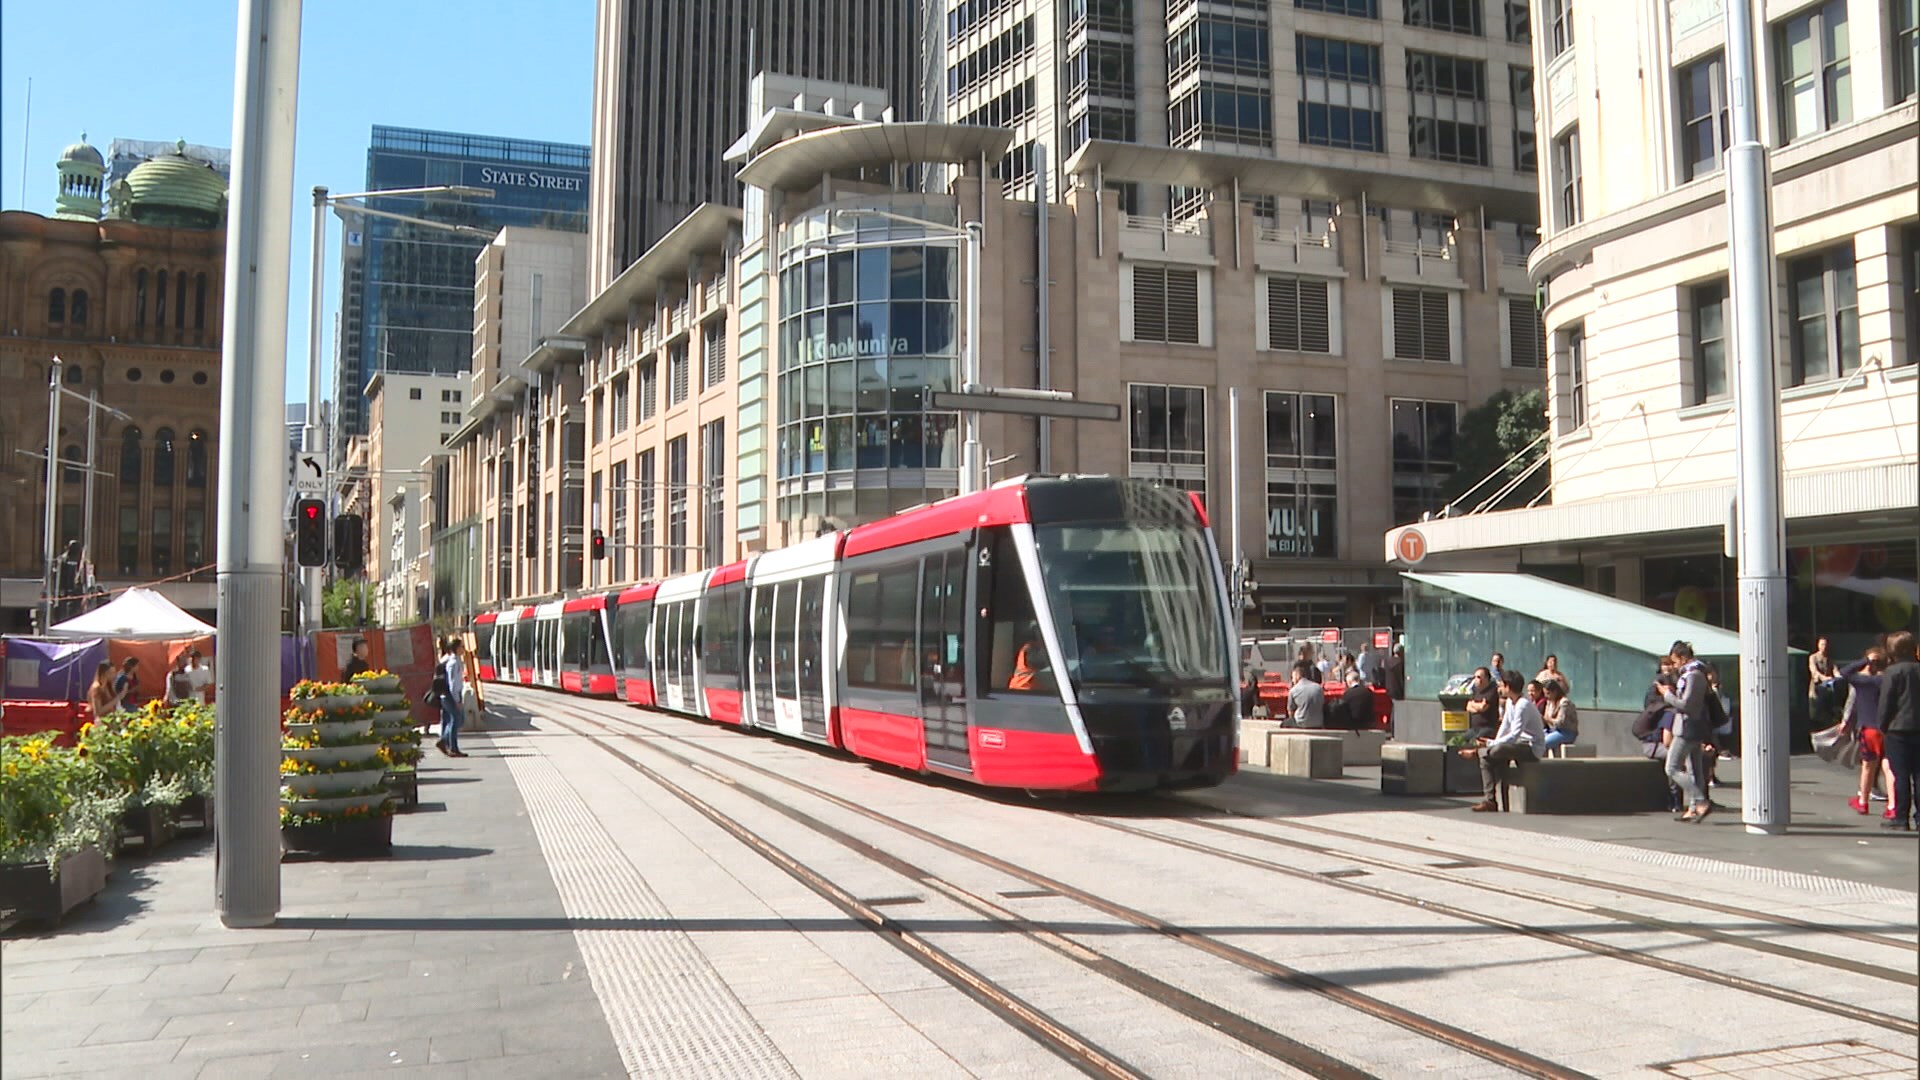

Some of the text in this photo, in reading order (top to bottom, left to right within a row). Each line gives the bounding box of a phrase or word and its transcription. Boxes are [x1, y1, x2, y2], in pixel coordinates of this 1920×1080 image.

[481, 167, 583, 191] STATE STREET
[813, 333, 908, 360] Knokuniya
[298, 480, 324, 489] ONLY
[1405, 537, 1418, 559] T
